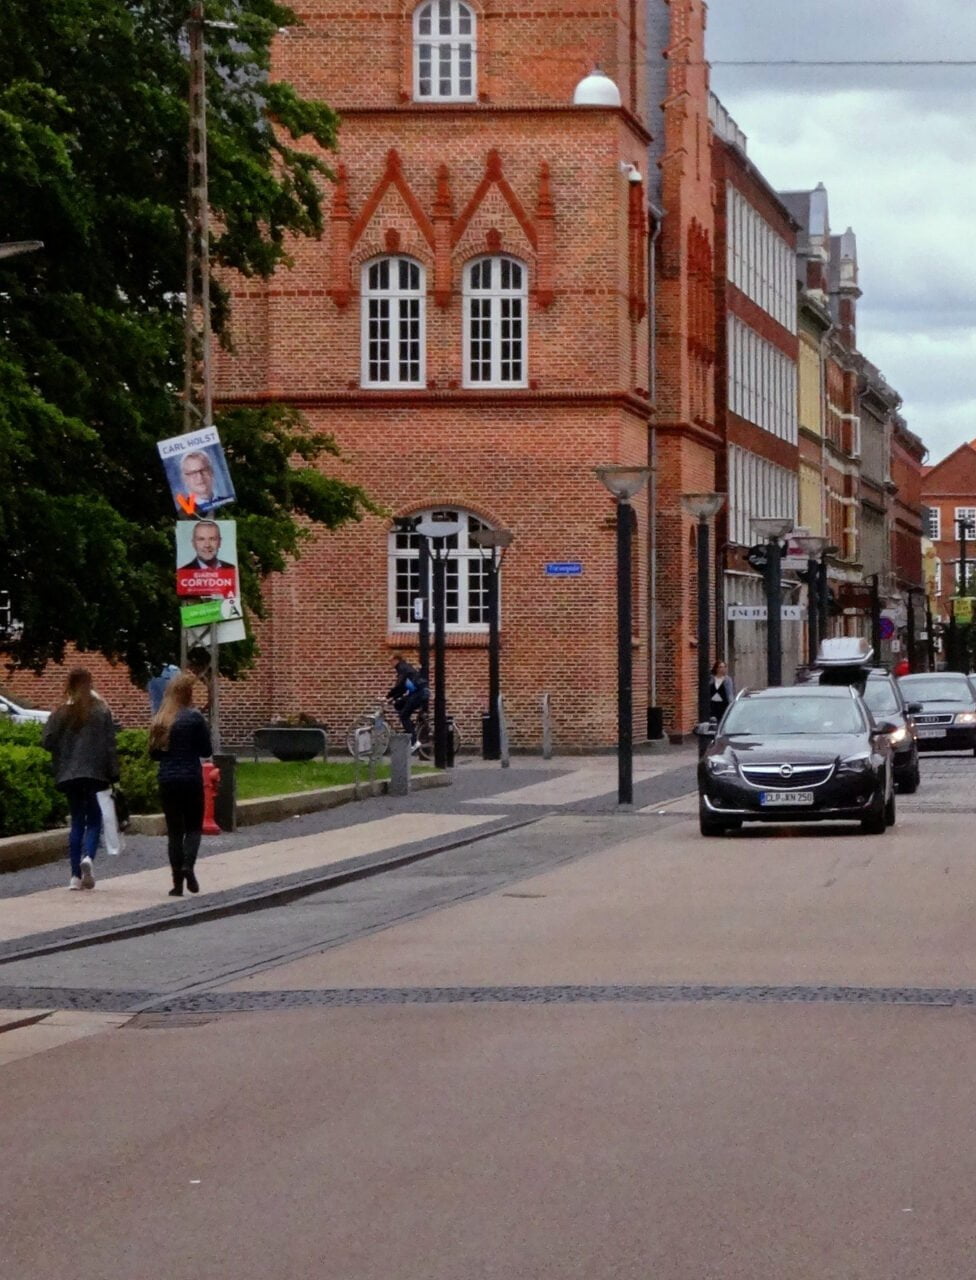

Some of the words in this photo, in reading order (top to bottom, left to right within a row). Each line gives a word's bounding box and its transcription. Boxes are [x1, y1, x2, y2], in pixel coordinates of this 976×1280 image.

[162, 442, 186, 455] CARL
[187, 432, 216, 447] HOLST
[180, 578, 232, 587] CORYDON
